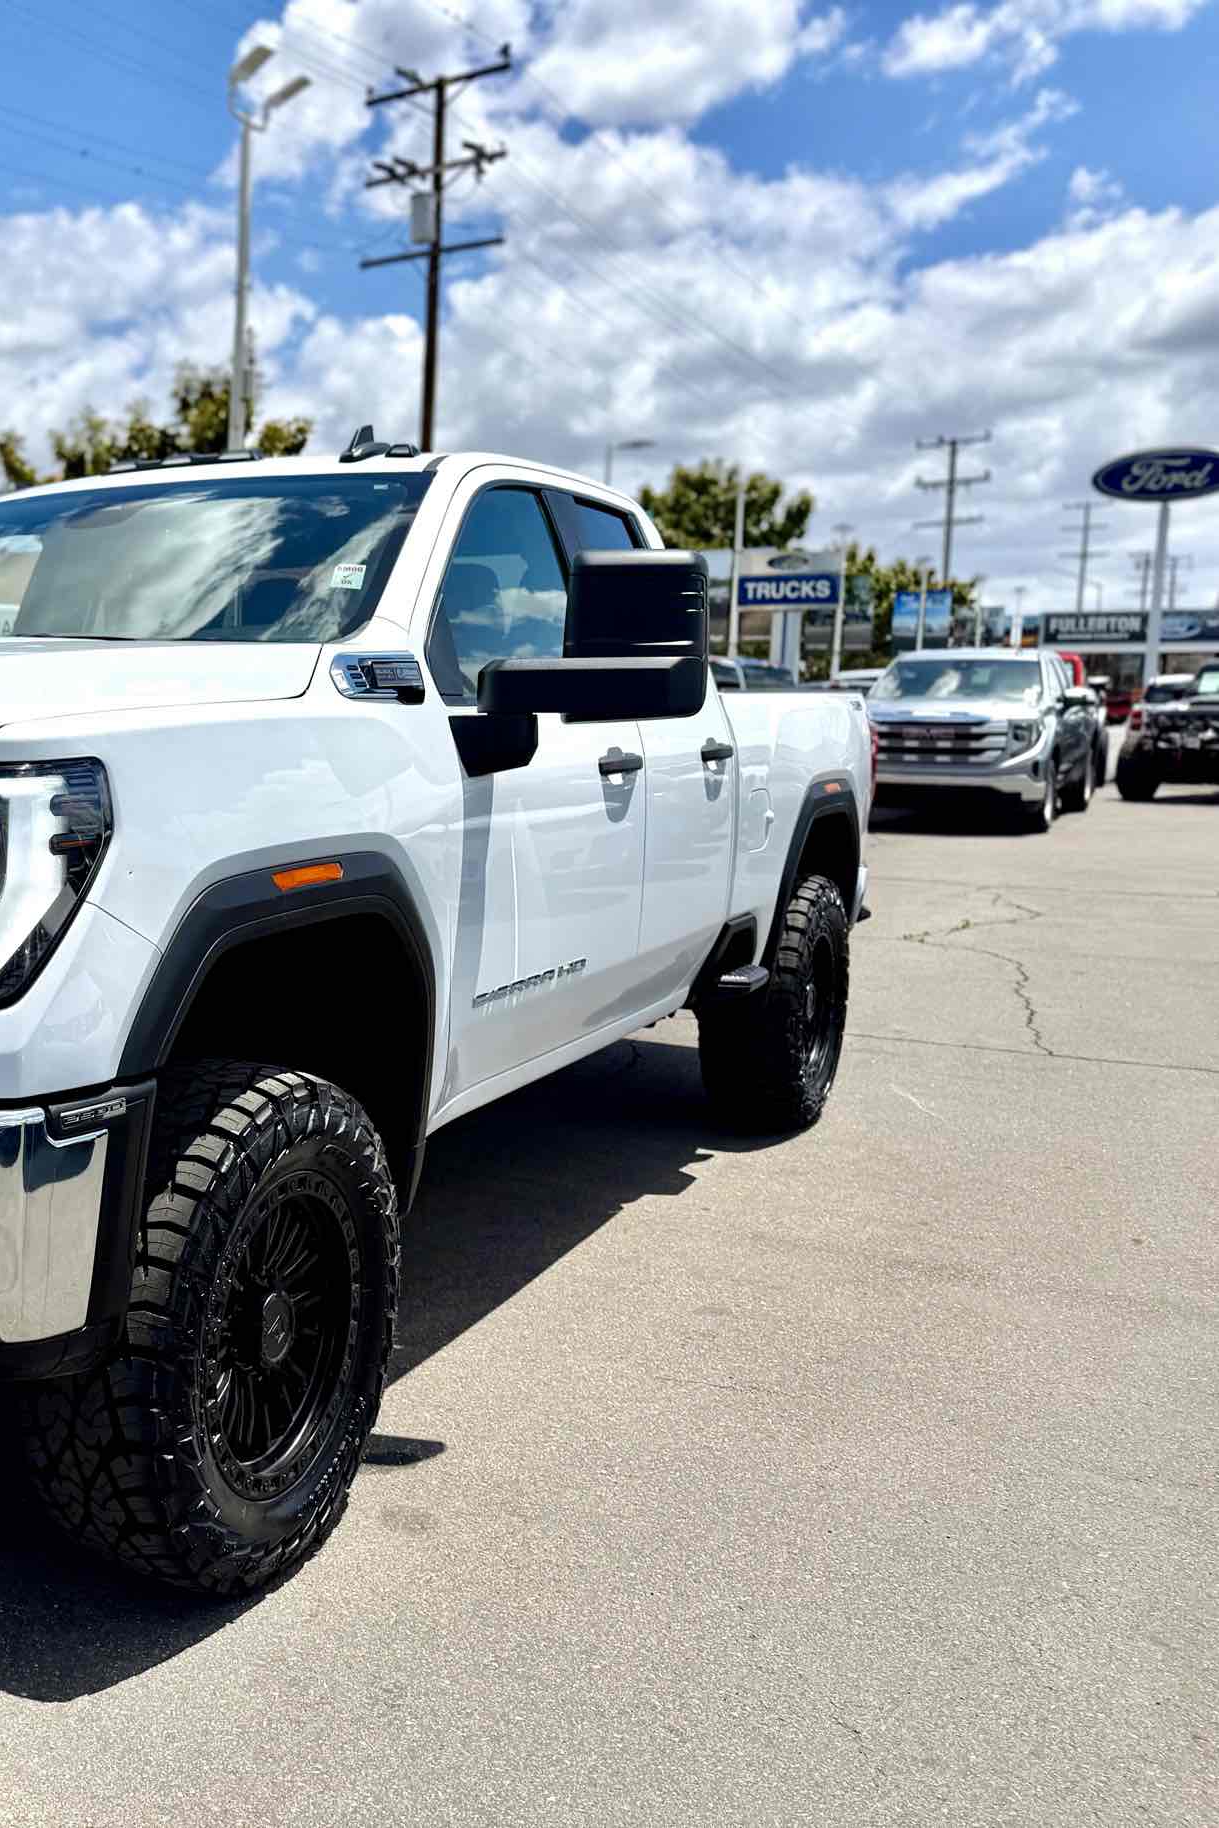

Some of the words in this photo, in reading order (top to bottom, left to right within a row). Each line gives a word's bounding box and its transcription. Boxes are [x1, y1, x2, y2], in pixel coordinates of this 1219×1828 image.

[1121, 457, 1214, 493] Ford
[744, 579, 831, 601] TRUCKS
[1049, 615, 1143, 633] FULLERTON
[472, 968, 556, 1009] SIERRA
[557, 957, 587, 979] HD
